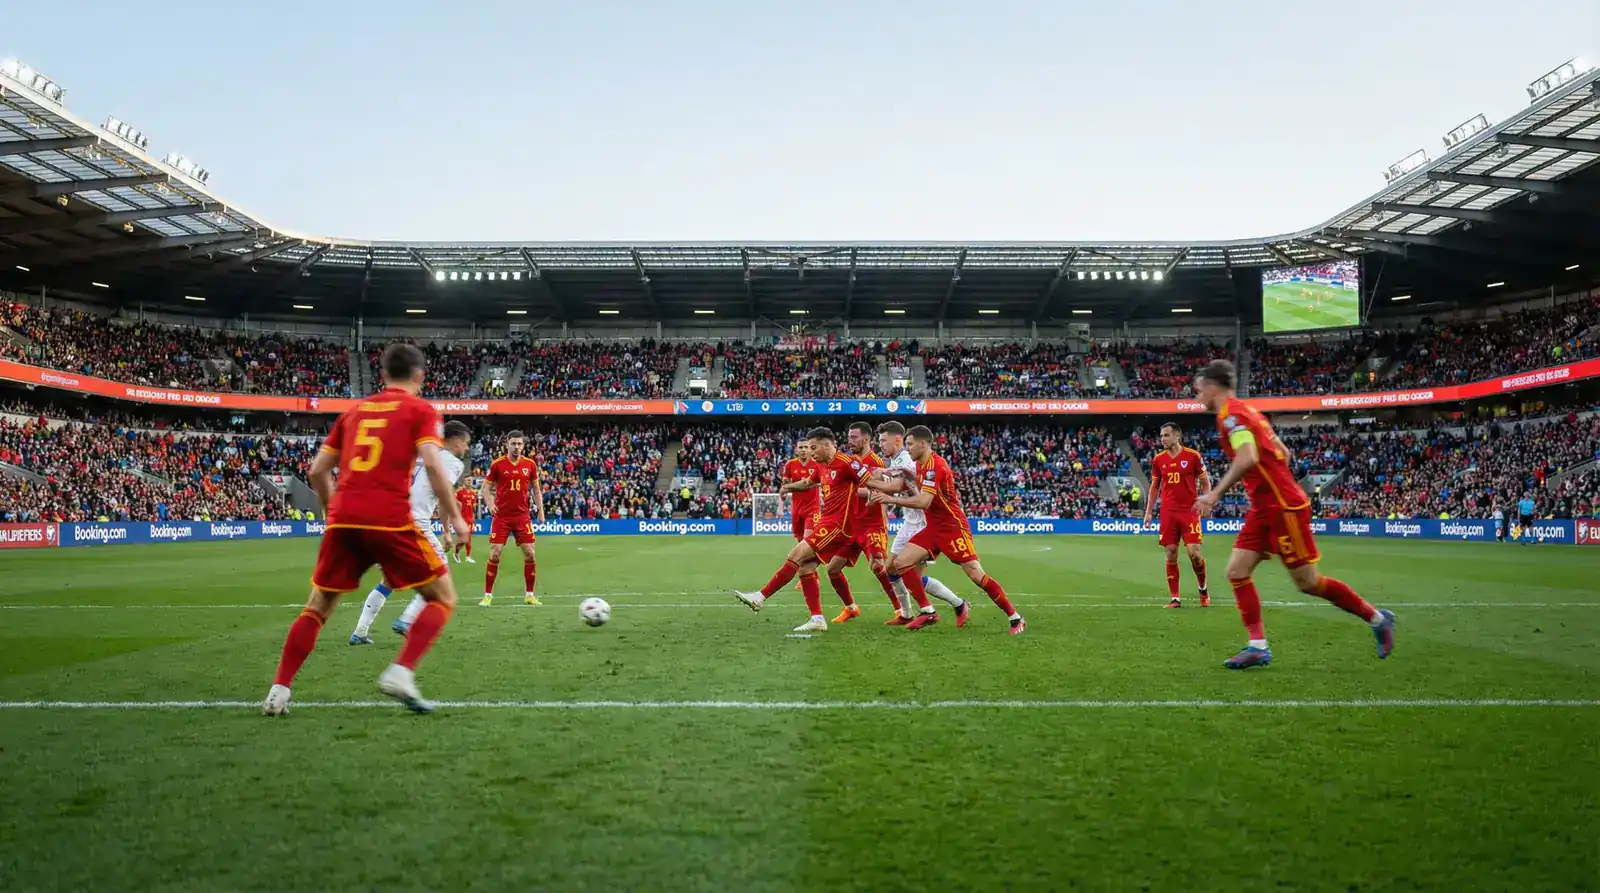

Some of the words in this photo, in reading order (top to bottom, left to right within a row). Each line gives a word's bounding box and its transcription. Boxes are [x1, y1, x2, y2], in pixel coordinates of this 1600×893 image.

[761, 402, 770, 412] 0
[348, 418, 388, 471] 5
[510, 480, 520, 491] 16
[1167, 472, 1180, 484] 20
[74, 525, 127, 543] Booking.com
[150, 523, 192, 540] Booking.com
[210, 523, 247, 538] Booking.com
[261, 522, 292, 536] Booking.com
[532, 520, 600, 535] ooking.com
[639, 521, 716, 534] Booking.com
[977, 520, 1054, 534] Booking.com
[1339, 520, 1370, 535] Booking.com
[1385, 521, 1421, 537] Booking.com
[1440, 522, 1484, 538] Booking.com
[950, 537, 967, 553] 18
